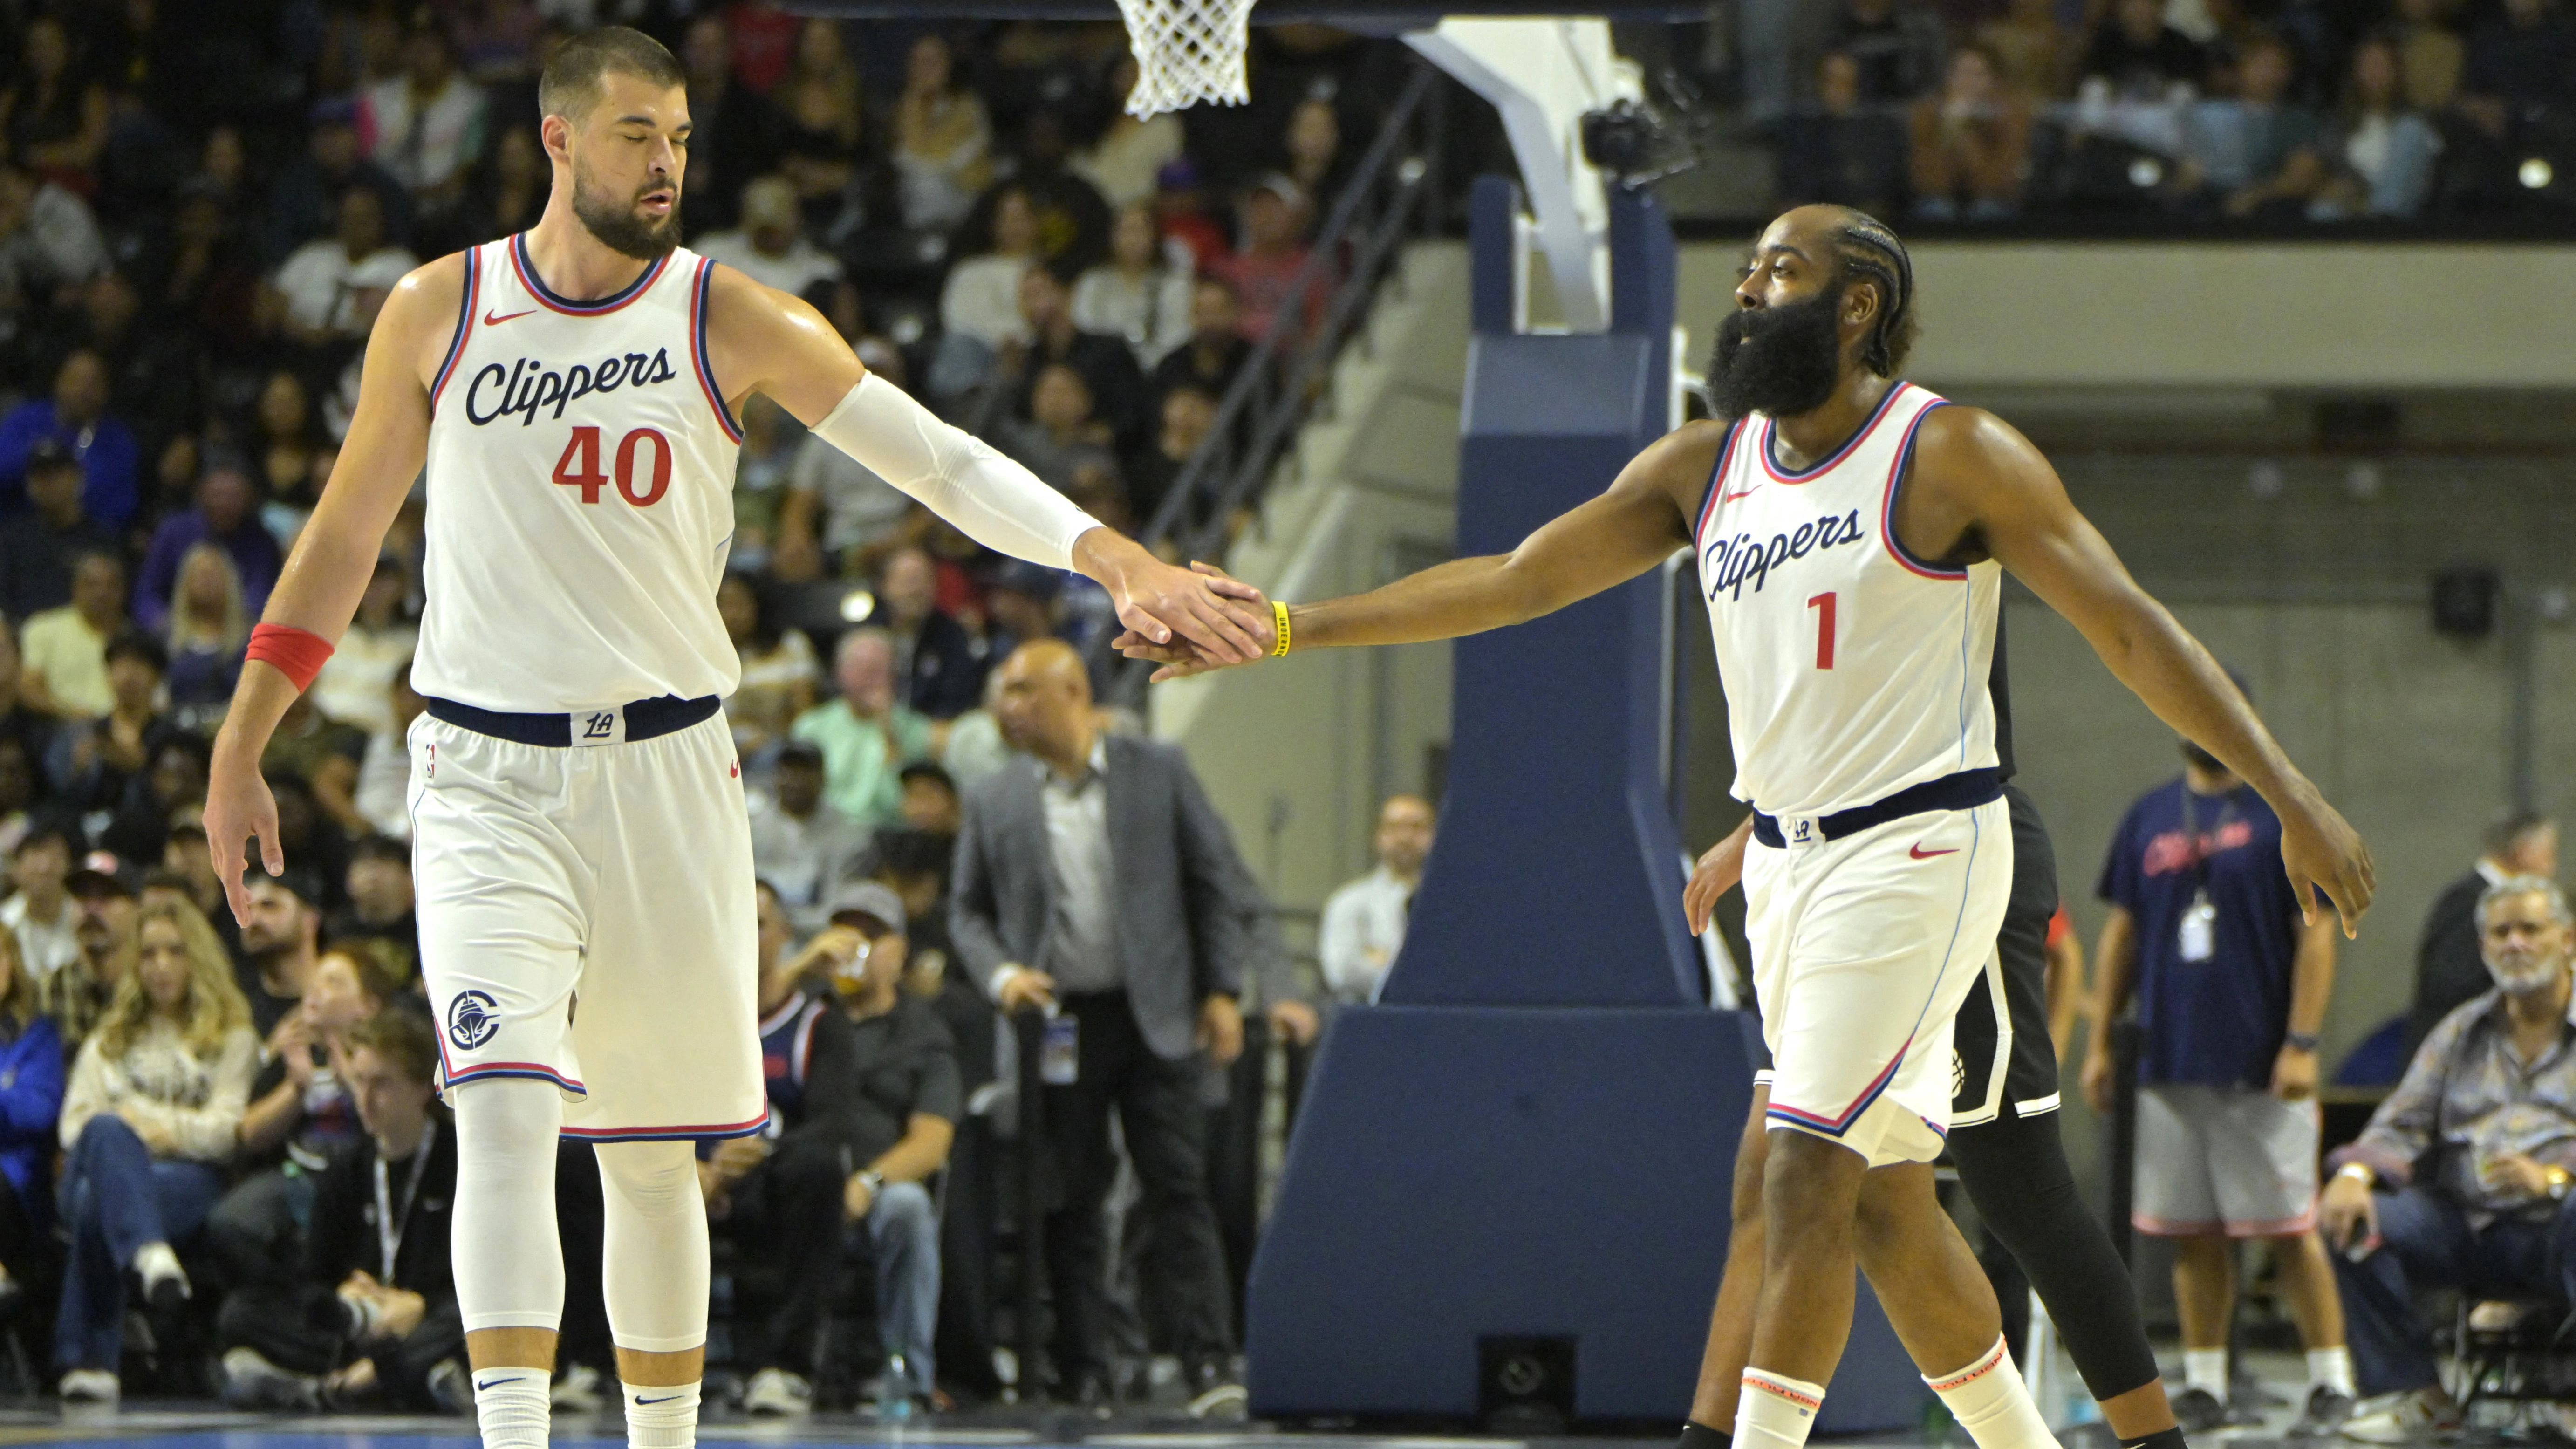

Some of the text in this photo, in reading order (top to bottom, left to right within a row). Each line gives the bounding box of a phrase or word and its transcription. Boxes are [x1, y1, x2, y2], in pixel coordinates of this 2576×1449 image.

[466, 347, 676, 427] Clippers
[552, 426, 672, 506] 40
[1706, 508, 1864, 602] Clippers
[1807, 592, 1837, 670] 1
[583, 712, 614, 738] LA
